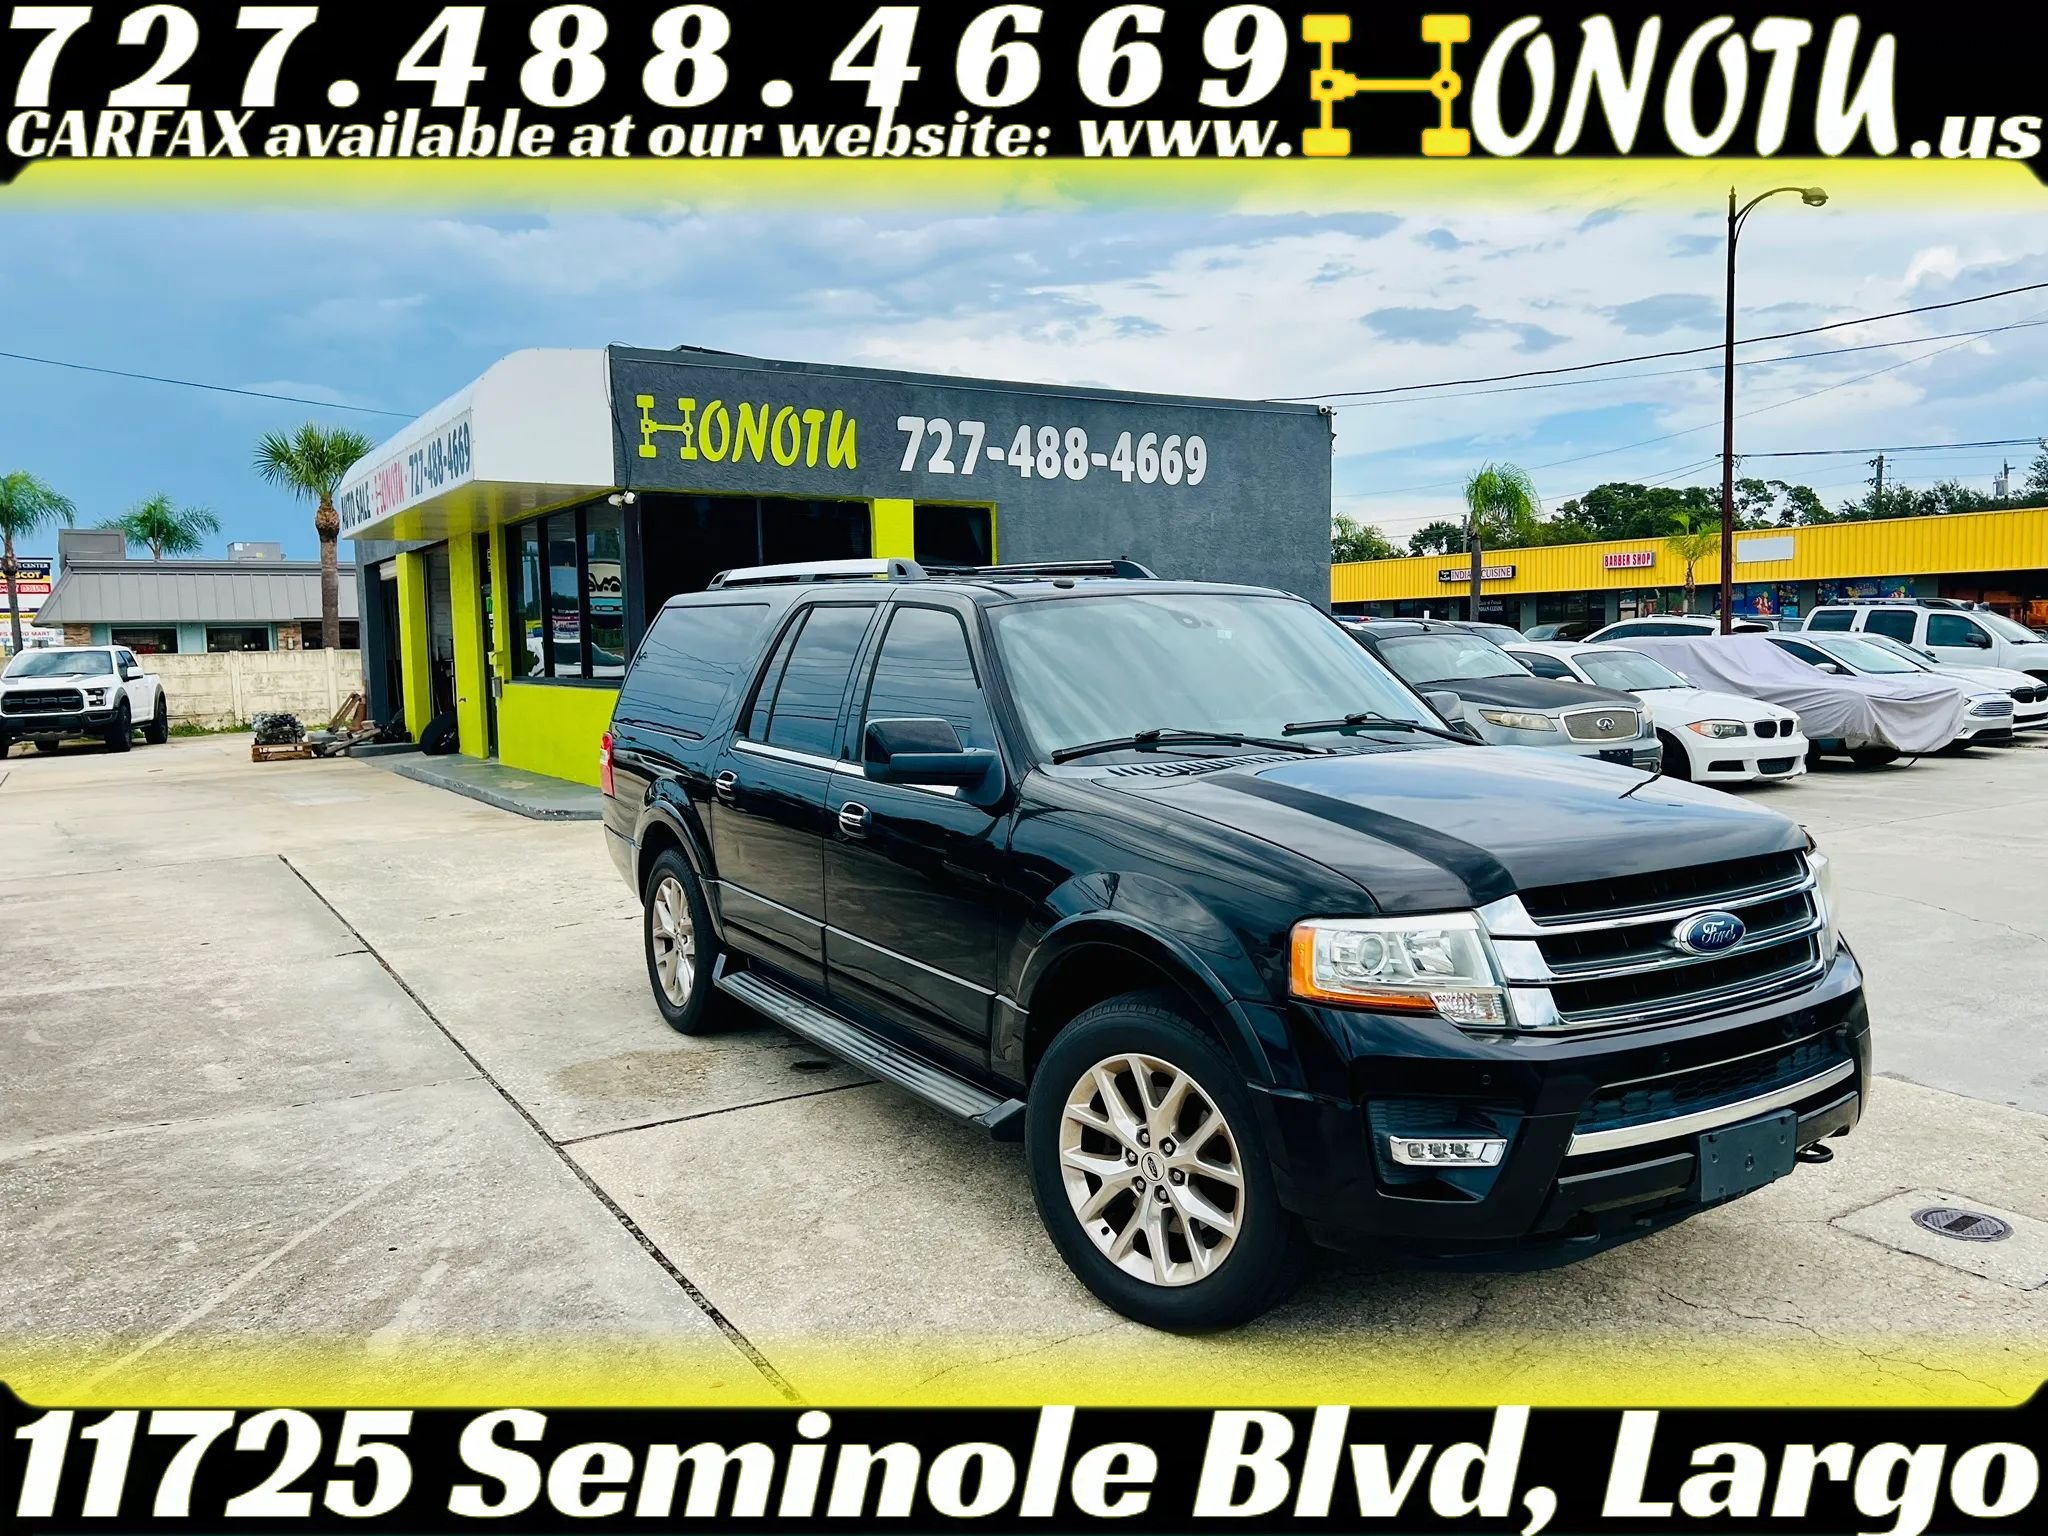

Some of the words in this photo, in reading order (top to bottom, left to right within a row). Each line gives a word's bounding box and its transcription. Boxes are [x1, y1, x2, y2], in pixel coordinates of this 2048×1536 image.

[897, 415, 1208, 486] 727-488-4669
[355, 481, 371, 524] SALE
[408, 421, 471, 498] 727-488-4669
[1605, 554, 1631, 567] BARBER
[1632, 553, 1651, 566] SHOP
[1451, 570, 1472, 580] INDIA
[1481, 567, 1511, 578] CUISINE
[1701, 920, 1736, 944] Ford
